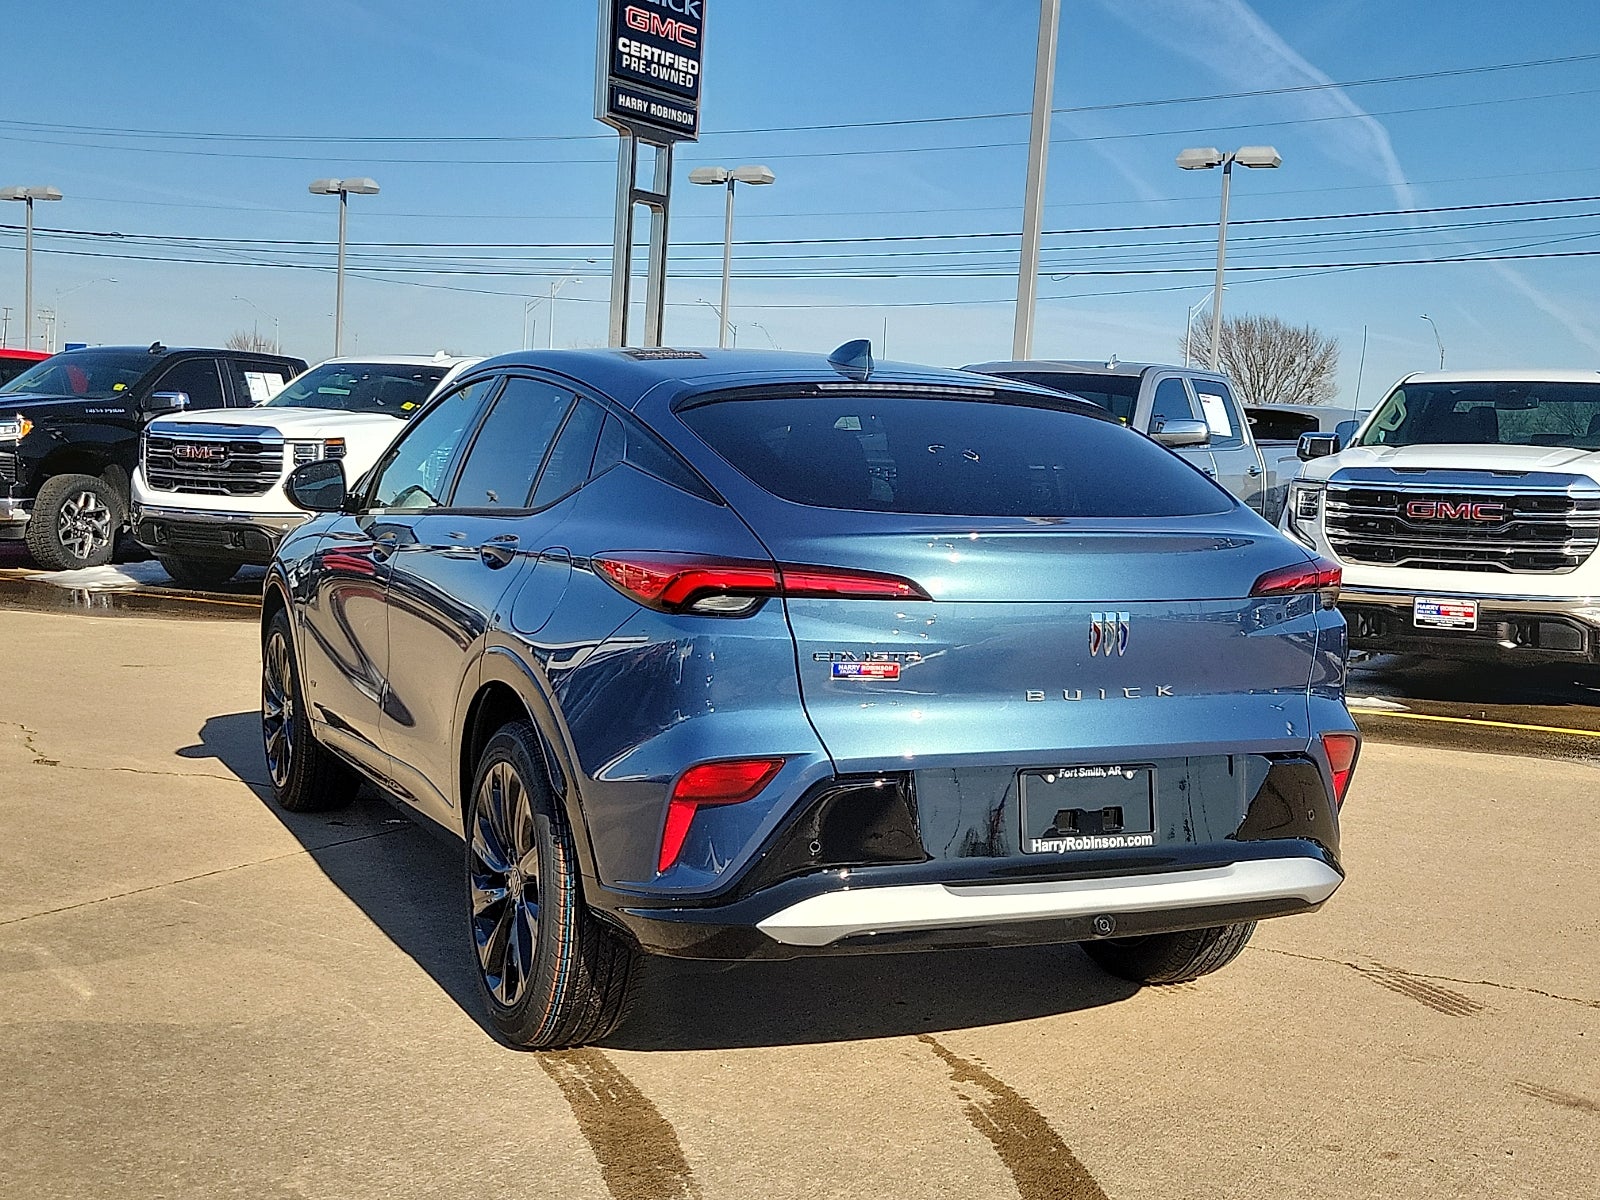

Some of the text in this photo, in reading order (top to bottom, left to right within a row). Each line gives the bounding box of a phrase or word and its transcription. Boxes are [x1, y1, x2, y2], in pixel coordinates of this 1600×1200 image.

[625, 5, 698, 49] GMC
[618, 37, 699, 75] CERTIFIED
[621, 55, 694, 88] PRE-OWNED
[618, 93, 694, 125] HARRY ROBINSON
[175, 445, 225, 460] GMC
[1406, 501, 1504, 521] GMC
[1026, 684, 1174, 702] BUICK
[1059, 766, 1122, 779] Fort Smith, AR
[1032, 834, 1154, 855] HarryRobinson.com
